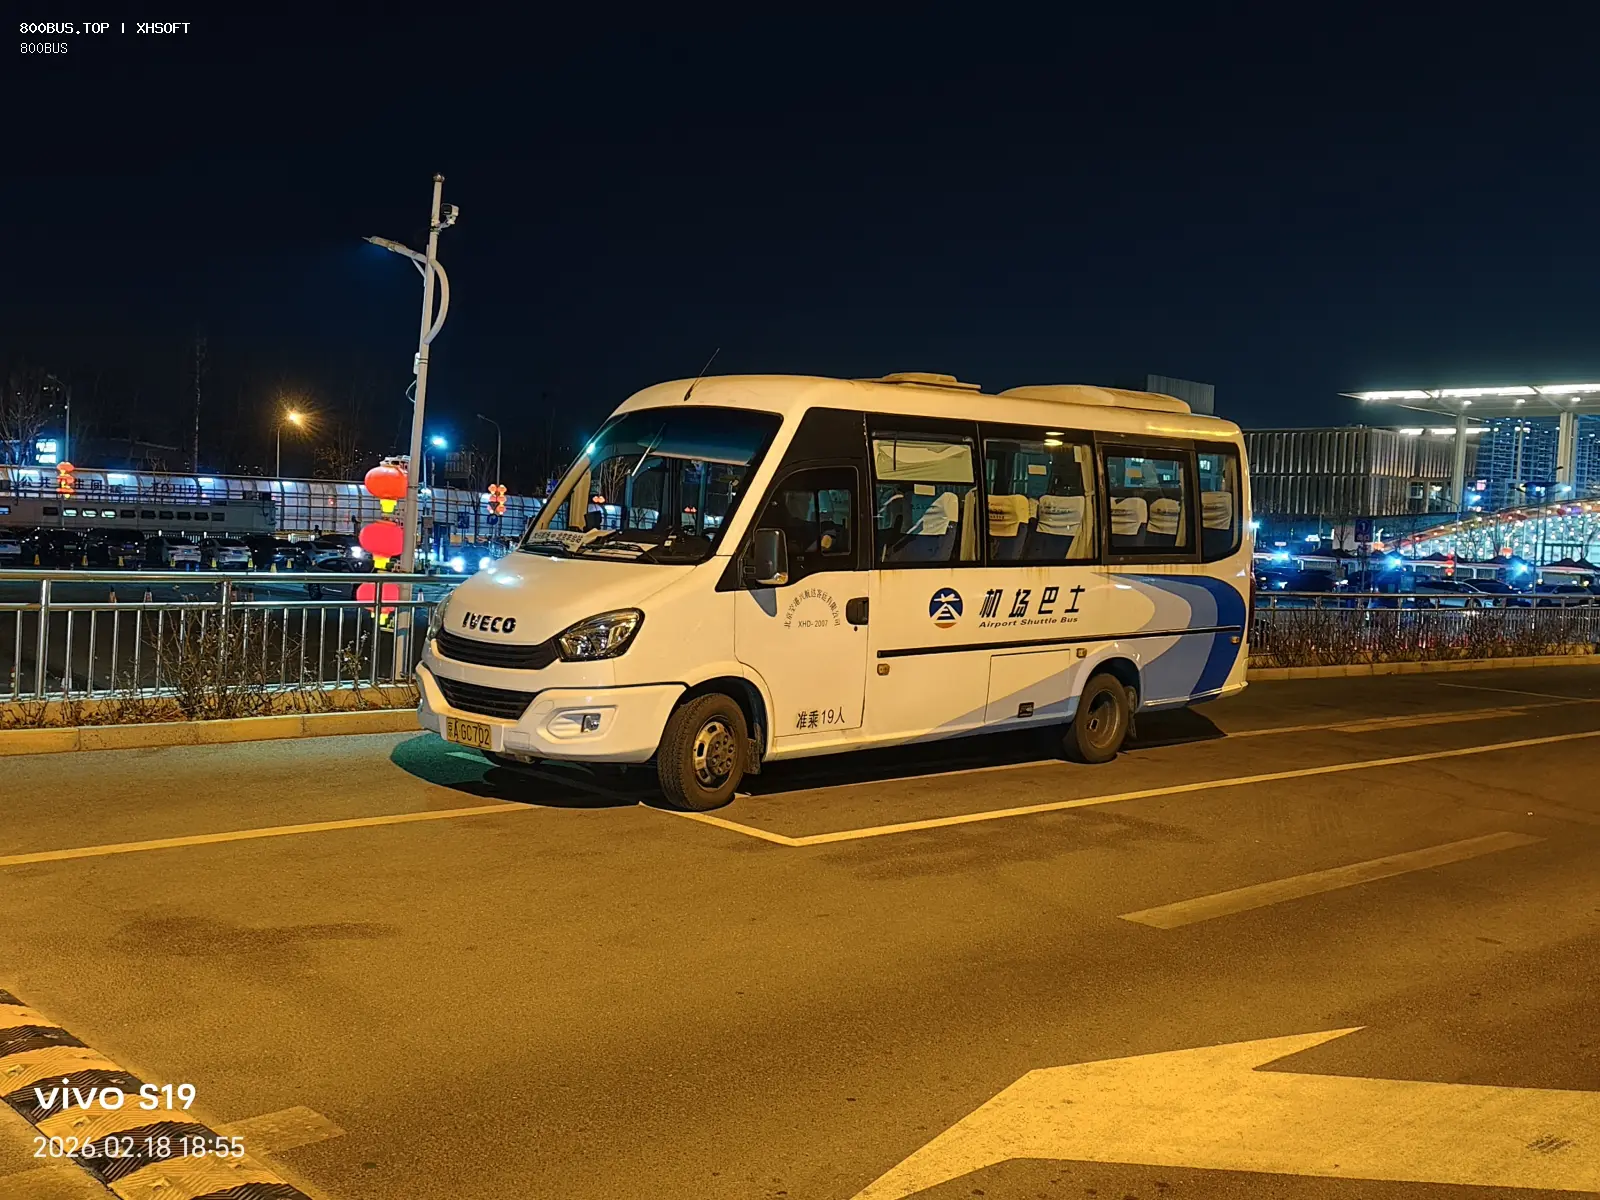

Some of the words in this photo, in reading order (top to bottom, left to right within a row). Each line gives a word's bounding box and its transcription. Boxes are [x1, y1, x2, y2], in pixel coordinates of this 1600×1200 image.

[979, 584, 1086, 619] 机场巴士
[462, 611, 517, 634] IVECO
[978, 619, 1017, 629] Airport
[1020, 617, 1057, 626] Shuttle
[1060, 615, 1078, 624] Bus
[796, 706, 846, 730] 准乘19人
